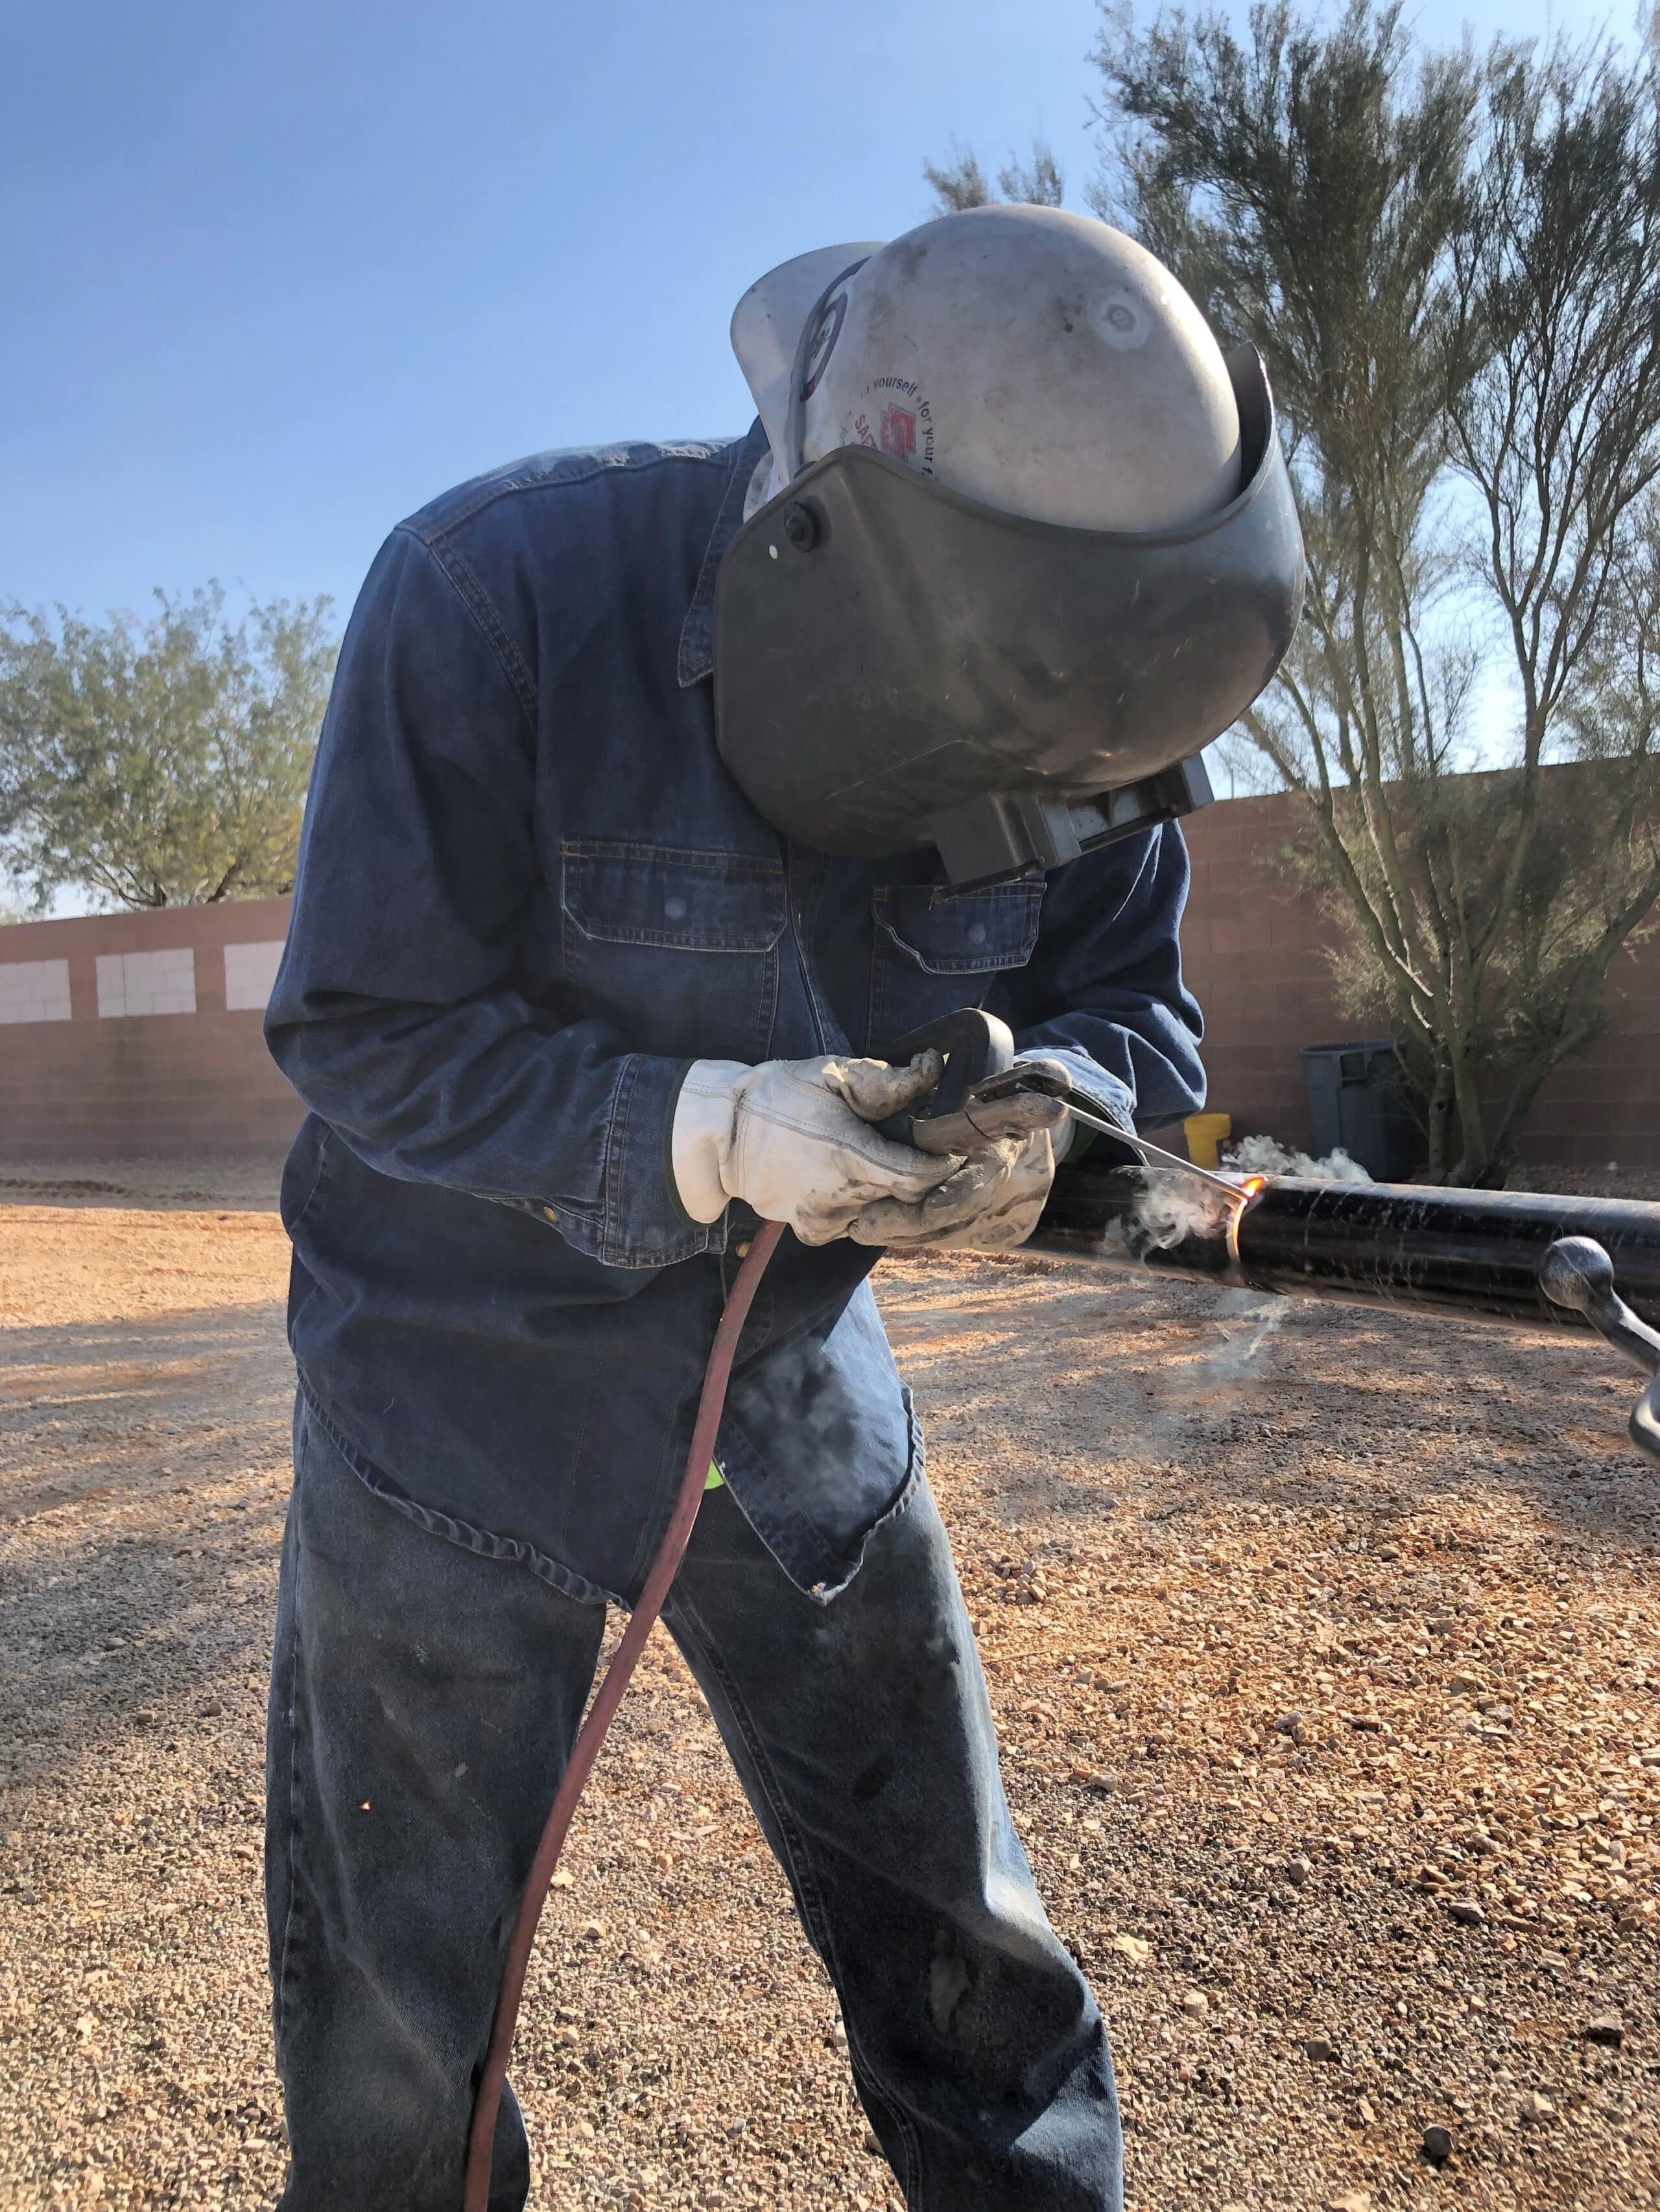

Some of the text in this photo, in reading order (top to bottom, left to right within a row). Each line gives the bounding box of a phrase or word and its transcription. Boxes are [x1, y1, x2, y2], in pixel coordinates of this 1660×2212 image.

[873, 377, 918, 397] yourself
[918, 401, 932, 423] for
[922, 427, 934, 464] your
